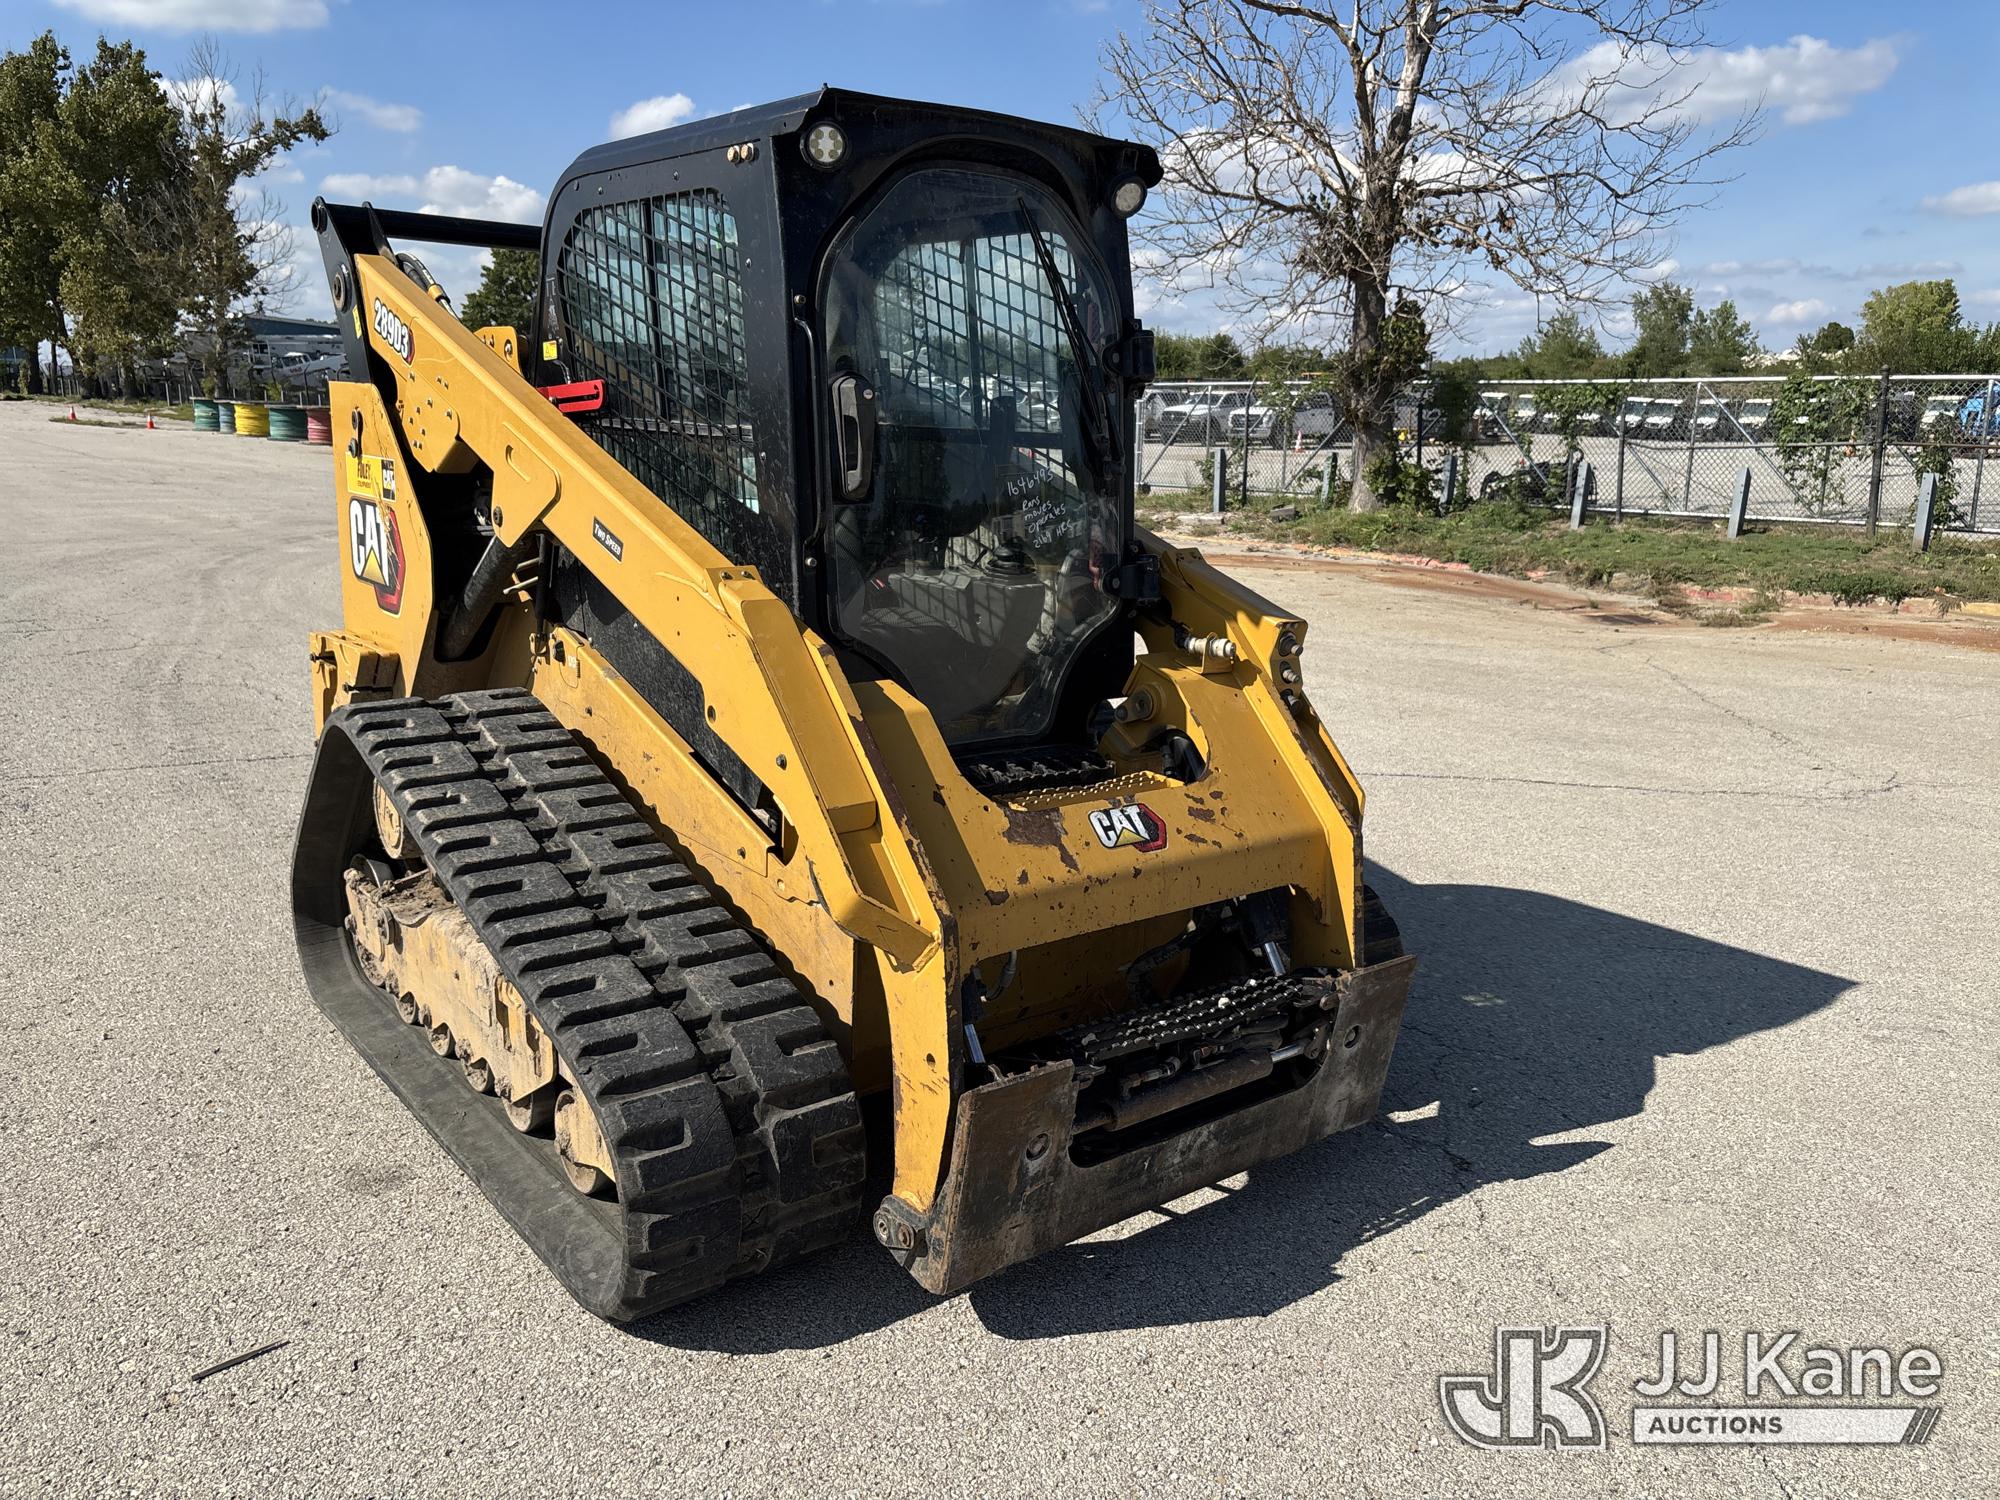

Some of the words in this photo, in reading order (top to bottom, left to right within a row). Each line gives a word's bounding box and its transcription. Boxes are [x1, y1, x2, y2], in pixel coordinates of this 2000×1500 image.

[374, 298, 409, 360] 289D3
[1007, 466, 1054, 496] 1646495
[350, 499, 390, 587] CAT
[1089, 804, 1151, 848] CAT
